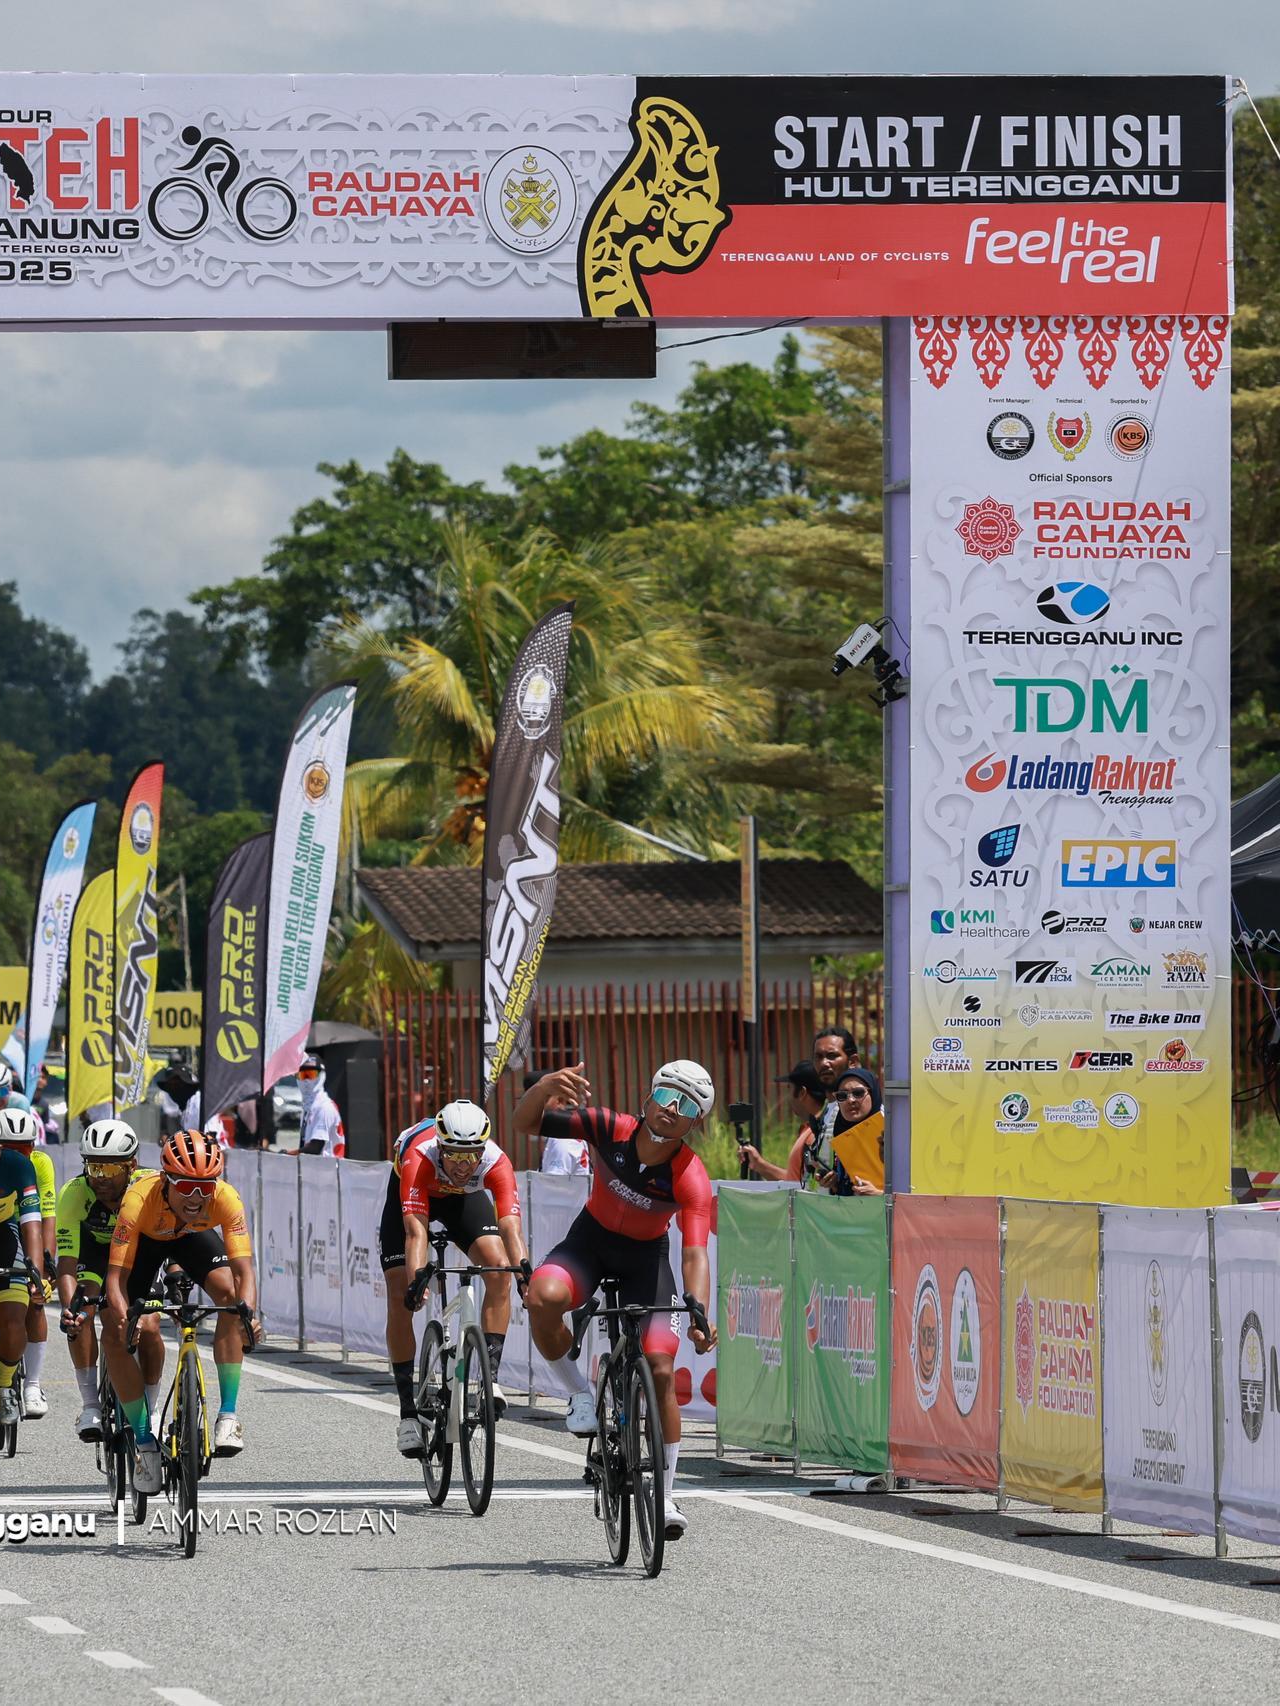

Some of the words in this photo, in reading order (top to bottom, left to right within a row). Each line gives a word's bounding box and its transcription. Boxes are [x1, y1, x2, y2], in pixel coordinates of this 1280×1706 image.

[774, 115, 944, 168] START
[960, 115, 981, 172] /
[1001, 115, 1181, 168] FINISH
[308, 172, 480, 193] RAUDAH
[784, 176, 892, 198] HULU
[902, 175, 1180, 197] TERENGGANU
[312, 196, 475, 217] CAHAYA
[0, 245, 119, 254] TERENGGANU
[965, 217, 1065, 264] feel
[1071, 220, 1129, 246] the
[721, 253, 814, 262] TERENGGANU
[819, 253, 855, 262] LAND
[861, 253, 879, 262] OF
[883, 252, 950, 261] CYCLISTS
[1060, 236, 1160, 283] real
[1123, 432, 1142, 441] KBS
[1029, 473, 1063, 483] Official
[1066, 473, 1113, 486] Sponsors
[1033, 502, 1191, 521] RAUDAH
[1037, 524, 1187, 543] CAHAYA
[1033, 547, 1191, 559] FOUNDATION
[849, 631, 872, 657] MYLAPS
[963, 631, 1136, 645] TERENGGANU
[1141, 631, 1183, 645] INC
[993, 677, 1148, 733] TDM
[1098, 791, 1174, 809] Trengganu
[295, 811, 316, 863] SUKAN
[1067, 846, 1171, 882] EPIC
[290, 864, 308, 898] DAN
[970, 870, 1029, 887] SATU
[300, 842, 326, 937] TERENGGANU
[283, 900, 303, 943] BELIA
[960, 910, 995, 924] KMI
[1065, 917, 1107, 927] PRO
[1148, 920, 1175, 930] NEJAR
[1177, 920, 1203, 930] CREW
[960, 926, 1030, 938] Healthcare
[220, 905, 244, 1016] PRO
[243, 905, 257, 1016] APPAREL
[292, 937, 313, 991] NEGERI
[1055, 966, 1068, 974] PG
[1090, 963, 1151, 976] ZAMAN
[83, 928, 105, 1025] PRO
[277, 944, 296, 1014] JABATAN
[1049, 974, 1072, 982] HCM
[1167, 972, 1206, 982] RAZIA
[489, 1019, 509, 1084] MAJLIS
[504, 959, 528, 1018] SUKAN
[1109, 1014, 1134, 1024] The
[1138, 1013, 1170, 1024] Bike
[923, 1063, 971, 1071] PERTAMA
[985, 1060, 1058, 1071] ZONTES
[995, 1121, 1038, 1129] Terengganu
[1045, 1112, 1098, 1123] Terengganu
[610, 1178, 652, 1204] ARMED
[1038, 1299, 1095, 1338] RAUDAH
[1039, 1343, 1095, 1386] CAHAYA
[1038, 1385, 1095, 1417] FOUNDATION
